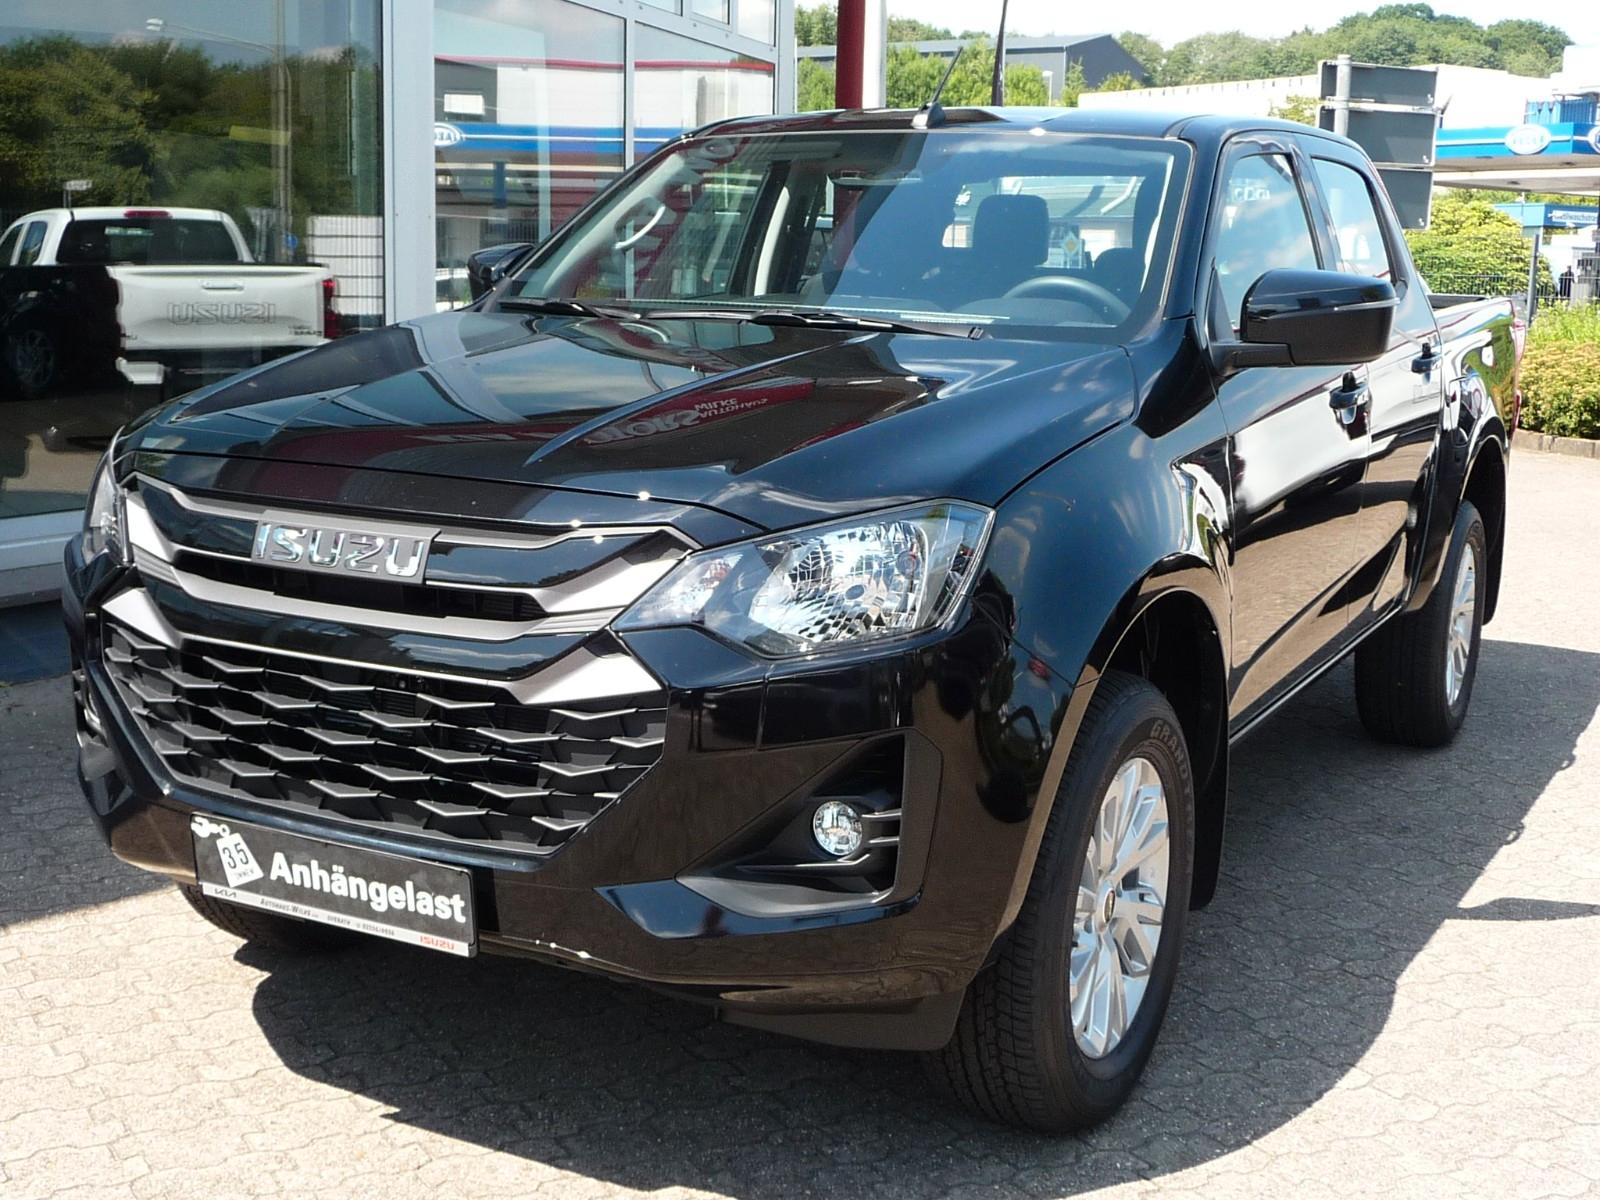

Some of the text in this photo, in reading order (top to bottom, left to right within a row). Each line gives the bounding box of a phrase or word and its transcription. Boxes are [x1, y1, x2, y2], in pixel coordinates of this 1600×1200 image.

[254, 522, 425, 577] ISUZU
[269, 851, 467, 923] Anhängelast
[420, 935, 455, 950] ISUZU
